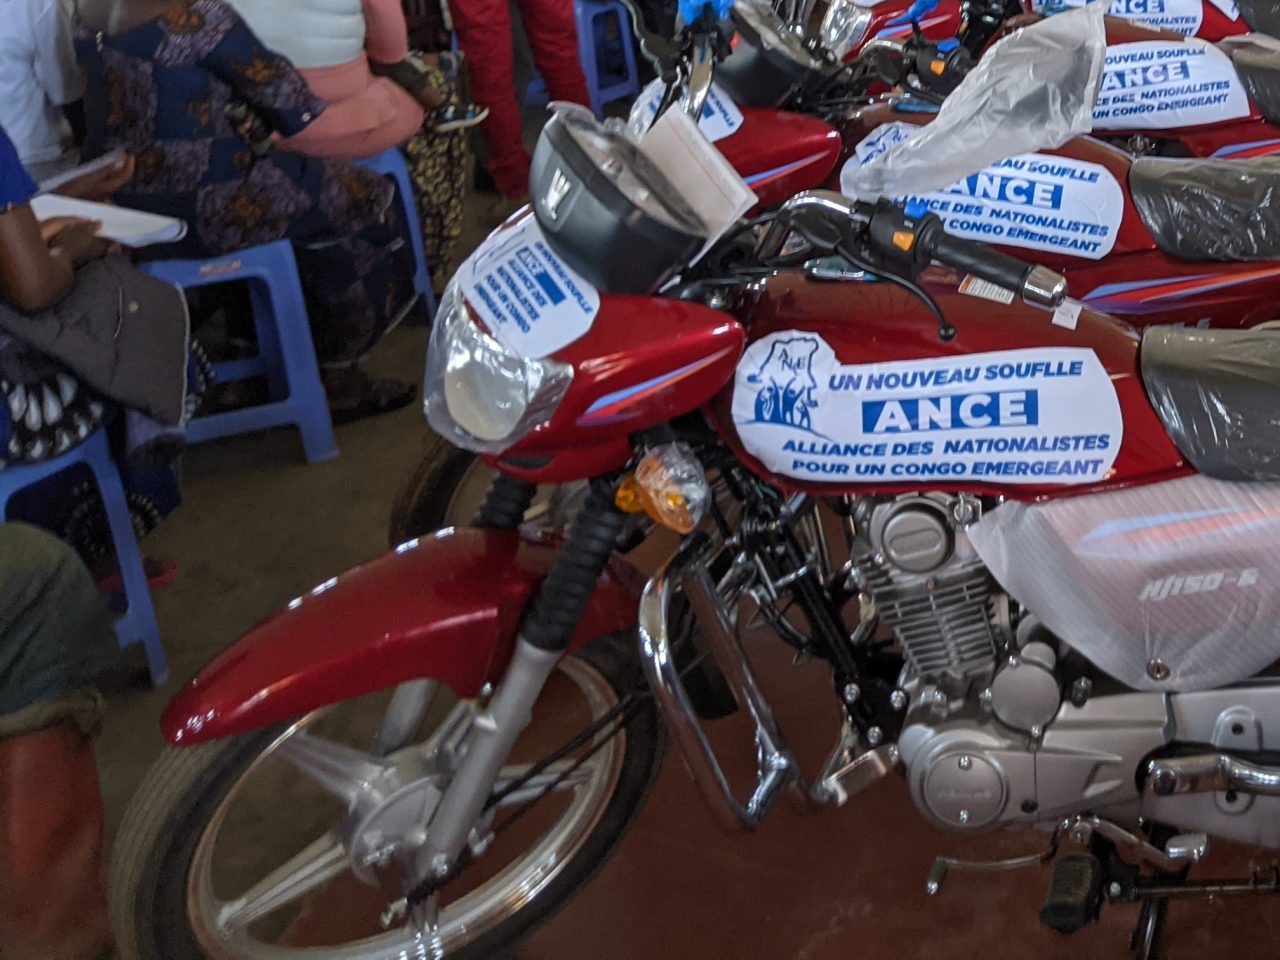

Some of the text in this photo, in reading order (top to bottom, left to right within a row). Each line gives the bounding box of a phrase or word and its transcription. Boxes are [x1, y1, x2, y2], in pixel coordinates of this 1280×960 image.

[1104, 50, 1154, 66] OUVEAU
[1101, 62, 1186, 90] ANCE
[1140, 80, 1231, 101] NATIONALISTES
[1112, 104, 1155, 117] CONGO
[1028, 160, 1101, 184] SOUFLLE
[952, 203, 983, 217] DES
[989, 208, 1110, 237] NATIONALISTES
[948, 220, 1004, 236] CONGO
[1006, 226, 1102, 253] EMERGEANT
[828, 360, 1083, 391] UN NOUVEAU SOUFLLE
[872, 392, 1029, 433] ANCE
[782, 434, 1110, 457] ALLIANCE DES NATIONALISTES
[791, 459, 1104, 476] POUR UN CONGO EMERGEANT
